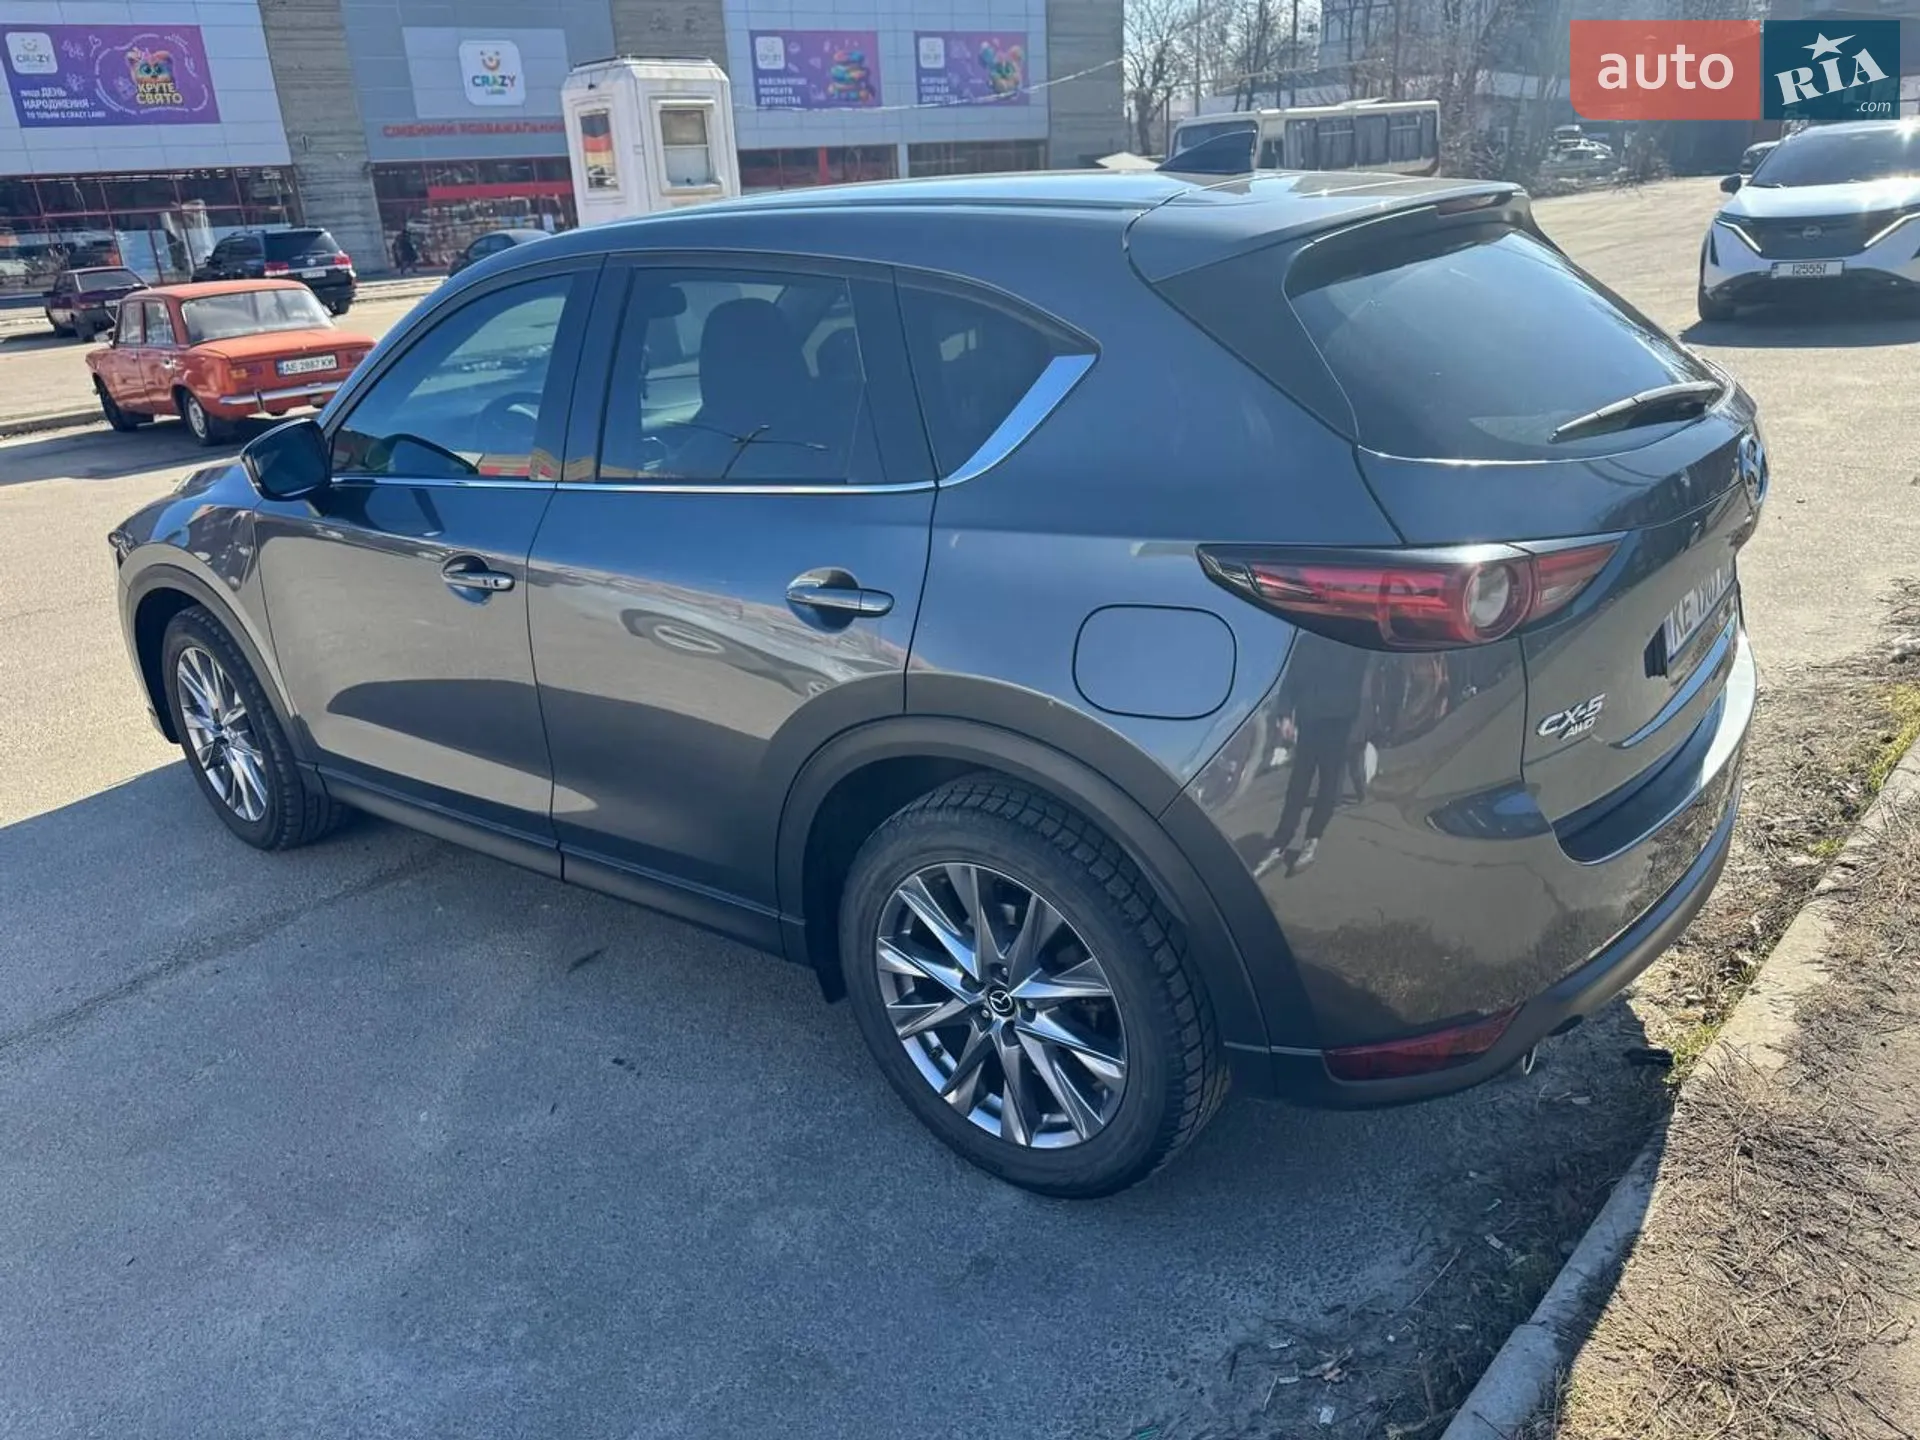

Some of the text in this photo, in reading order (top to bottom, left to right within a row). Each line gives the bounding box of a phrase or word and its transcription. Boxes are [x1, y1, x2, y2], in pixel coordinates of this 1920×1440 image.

[471, 74, 516, 87] CRAZY
[138, 82, 175, 93] КРУТЕ
[136, 92, 183, 104] СВЯТО
[1537, 693, 1606, 737] CX-5
[1561, 716, 1597, 741] AWD
